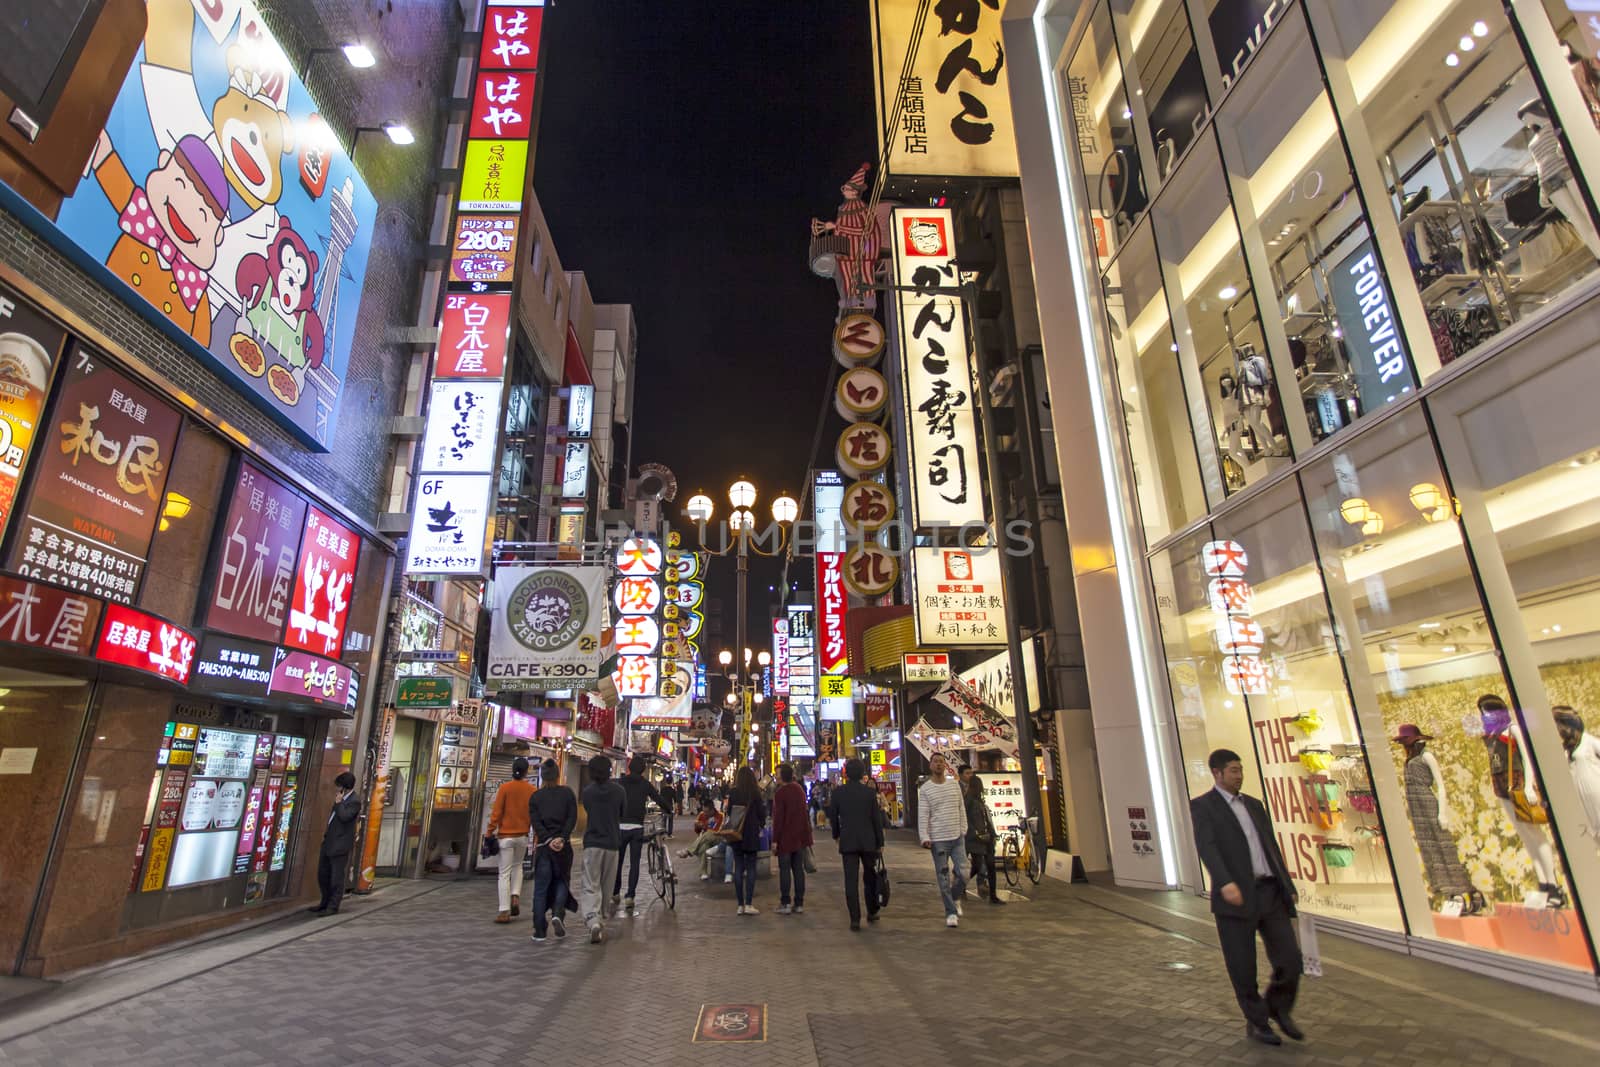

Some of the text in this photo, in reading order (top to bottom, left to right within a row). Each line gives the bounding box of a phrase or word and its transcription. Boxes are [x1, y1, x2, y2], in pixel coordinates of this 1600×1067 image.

[491, 10, 531, 66] はや
[482, 76, 523, 135] はや
[899, 77, 928, 154] 道頓堀店
[483, 145, 504, 199] 鳥貴族
[447, 296, 467, 310] 2F
[471, 282, 488, 292] 3F
[454, 302, 490, 373] 白木屋
[1350, 252, 1404, 384] FOREVER
[75, 350, 95, 375] 7F
[108, 388, 148, 425] 居食屋
[450, 391, 484, 461] ぼてぢゅう
[60, 401, 164, 501] 和民
[58, 471, 145, 517] JAPANESE CASUAL DINING
[240, 471, 254, 488] 2F
[422, 480, 444, 495] 6F
[73, 518, 115, 543] WATAMI
[249, 487, 293, 531] 居楽屋
[308, 513, 320, 530] 8F
[29, 527, 140, 579] 宴会予約受付中!!
[316, 525, 341, 560] 居楽屋
[23, 546, 136, 595] 宴会最大席数40席完備
[215, 515, 296, 627] 白木屋
[514, 575, 583, 606] DOUTONBORI
[614, 540, 657, 694] 大阪王将
[823, 554, 845, 659] ツルハドラッグ
[106, 621, 152, 652] 居楽屋
[513, 619, 581, 648] ZERO Cafe
[580, 637, 598, 651] 2F
[304, 660, 337, 697] 和民
[490, 663, 540, 677] CAFE
[179, 726, 195, 737] 3F
[1254, 716, 1300, 765] THE
[1264, 774, 1334, 826] WANT
[1277, 832, 1331, 886] LIST
